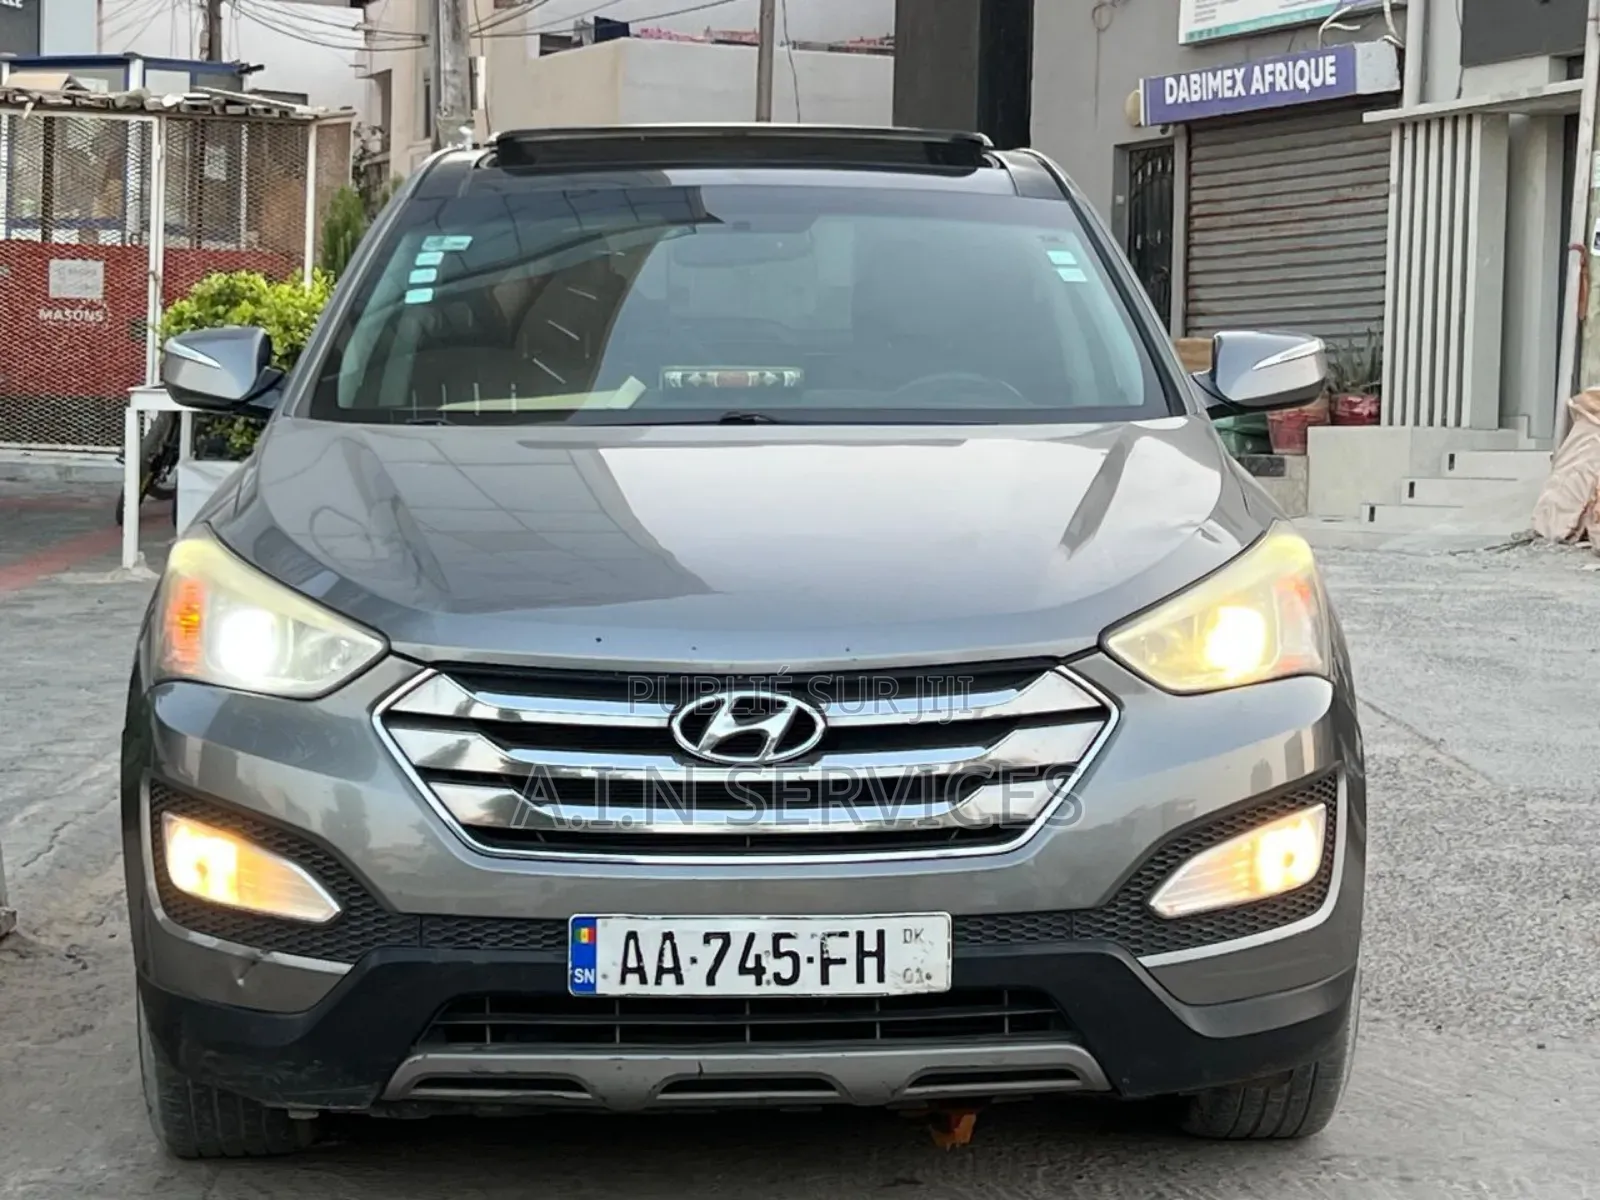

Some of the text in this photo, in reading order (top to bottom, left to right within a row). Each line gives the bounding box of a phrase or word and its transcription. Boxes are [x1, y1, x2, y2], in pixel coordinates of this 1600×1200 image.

[1164, 55, 1336, 105] DABIMEX AFRIQUE
[903, 928, 925, 945] DK
[574, 967, 596, 984] SN
